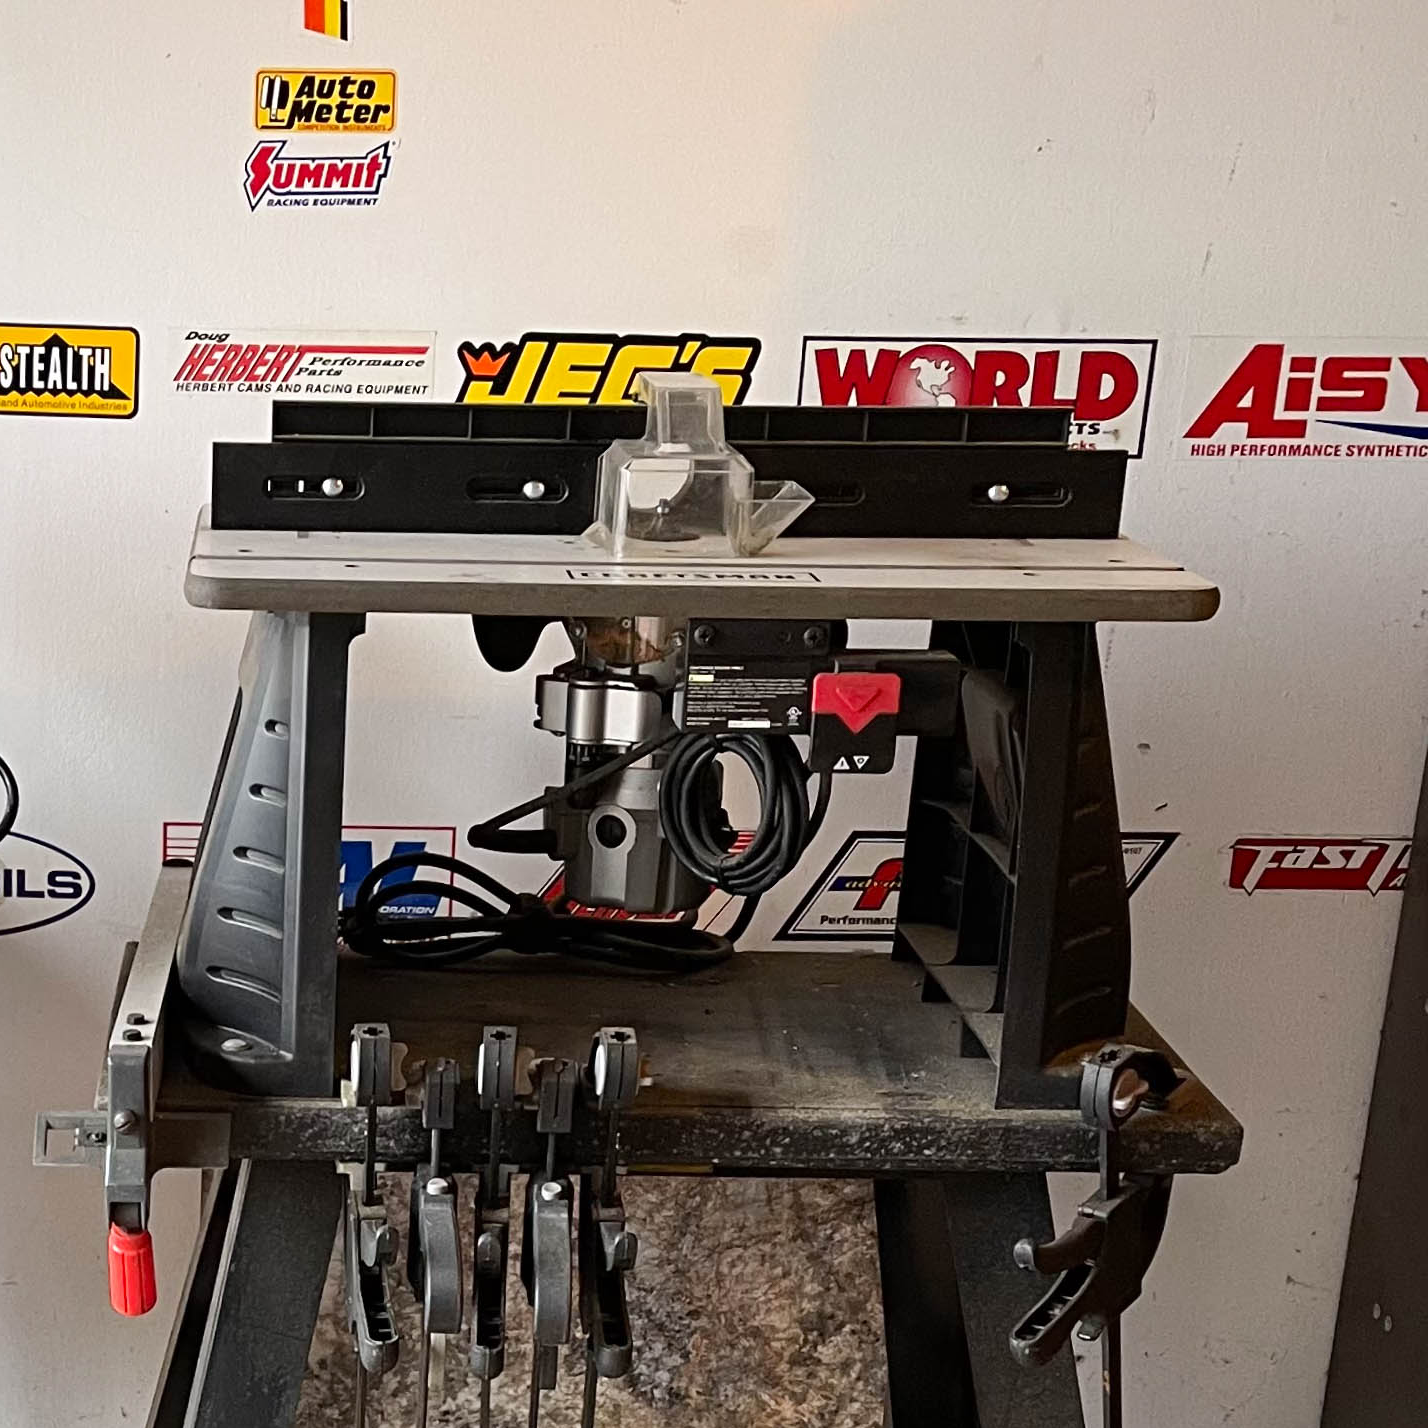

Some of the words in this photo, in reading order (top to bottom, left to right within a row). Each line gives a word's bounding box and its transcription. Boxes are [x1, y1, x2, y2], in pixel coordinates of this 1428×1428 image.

[295, 75, 376, 99] Auto
[288, 100, 391, 124] Meter
[185, 331, 230, 343] Doug
[173, 344, 307, 382] HERBERT
[309, 356, 425, 367] Performance
[295, 367, 343, 377] Parts
[815, 344, 1139, 421] WORLD
[176, 383, 234, 393] HERBERT
[237, 383, 272, 393] CAMS
[276, 384, 301, 393] AND
[305, 384, 352, 394] RACING
[357, 384, 429, 395] EQUIPMENT
[21, 399, 76, 410] Automotive
[1190, 444, 1225, 457] HIGH
[1230, 445, 1341, 457] PERFORMANCE
[820, 915, 897, 925] Performanc
